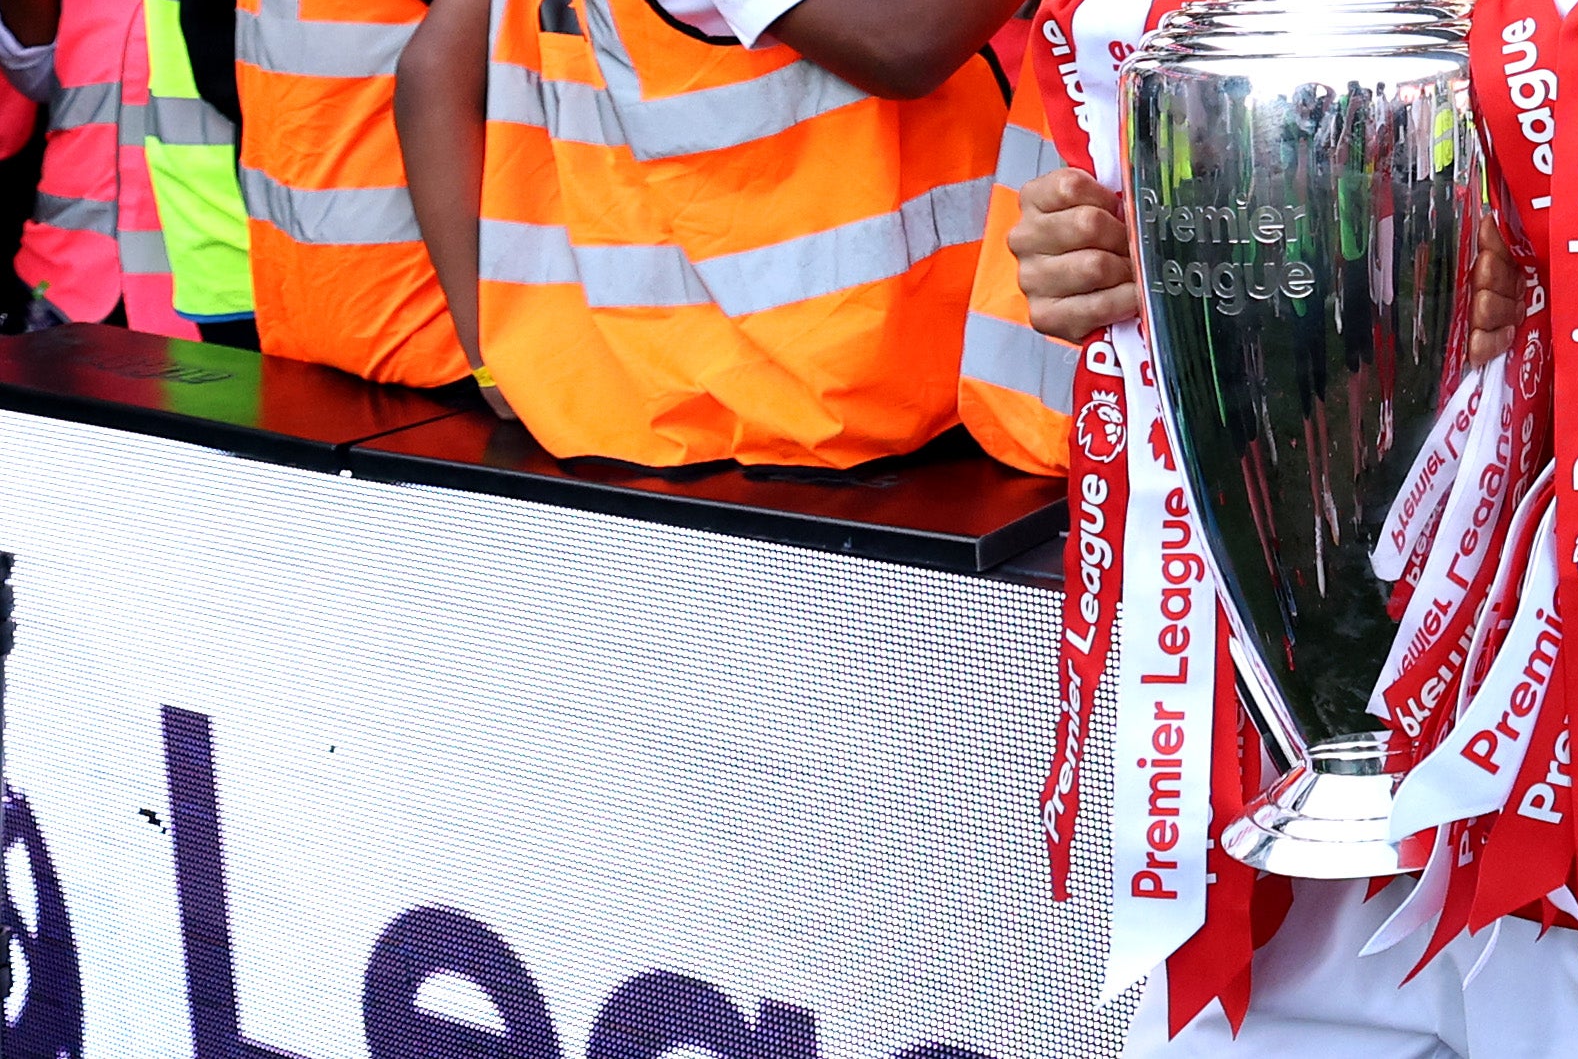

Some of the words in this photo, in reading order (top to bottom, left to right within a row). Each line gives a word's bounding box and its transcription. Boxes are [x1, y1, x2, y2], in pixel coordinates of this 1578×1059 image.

[1140, 187, 1307, 244] Premier
[1041, 659, 1084, 844] Premier
[1065, 473, 1113, 655] League
[1140, 486, 1206, 685] League
[1130, 700, 1187, 901] Premier
